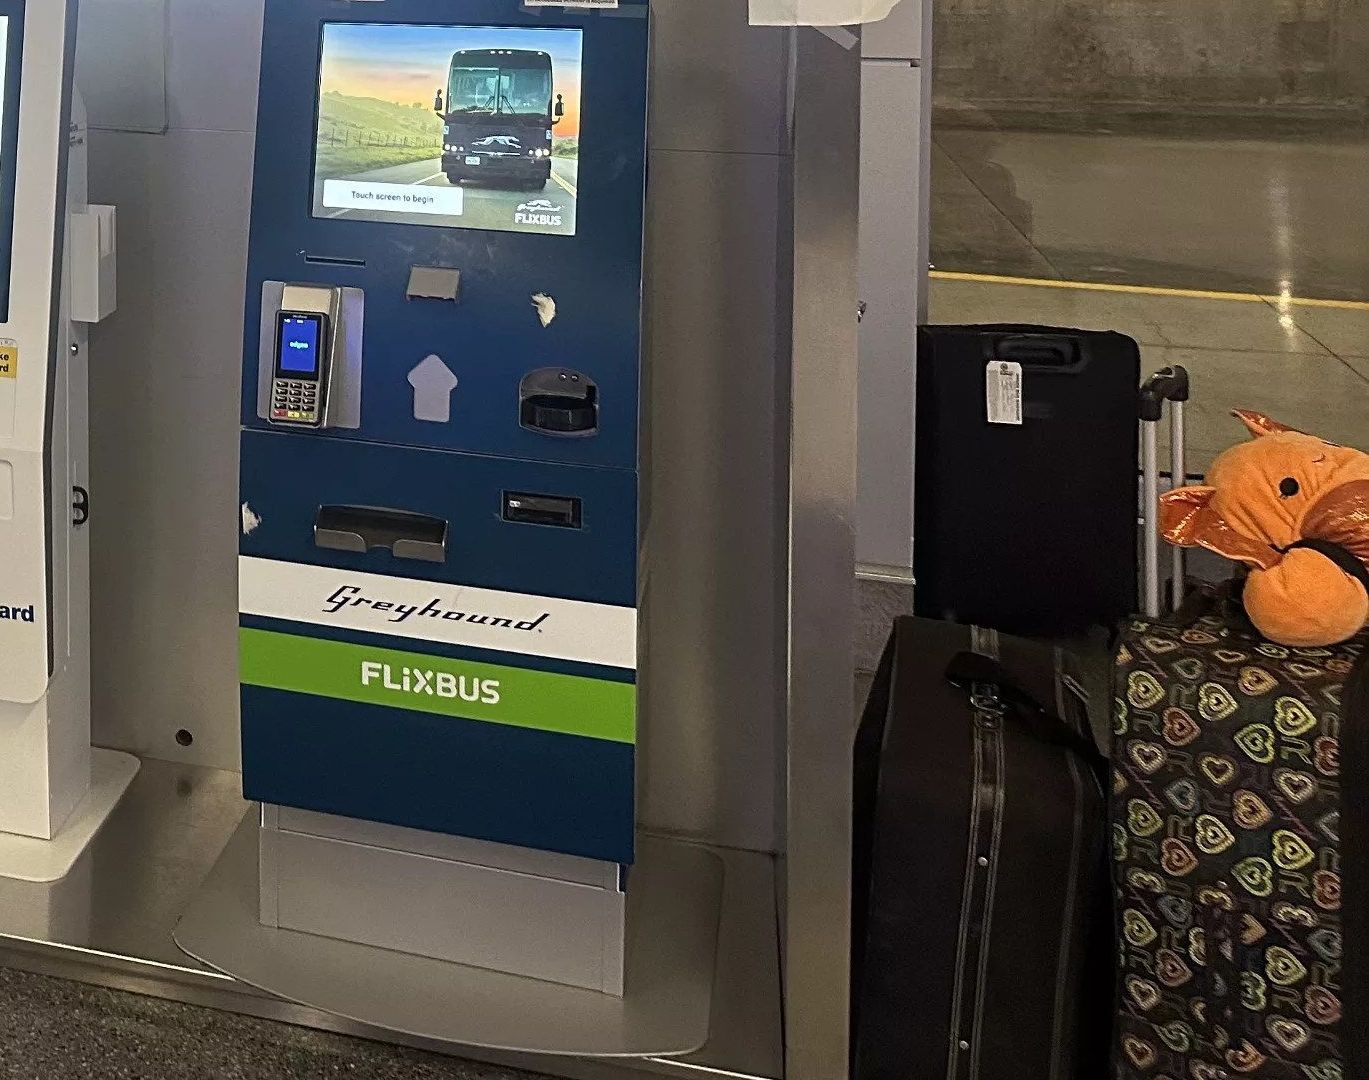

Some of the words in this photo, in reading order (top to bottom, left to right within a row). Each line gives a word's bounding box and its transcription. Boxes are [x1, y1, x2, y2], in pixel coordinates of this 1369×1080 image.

[351, 191, 374, 201] Touch
[376, 193, 402, 202] screen
[404, 193, 410, 202] to
[413, 194, 435, 205] begin
[322, 585, 550, 633] Greyhound
